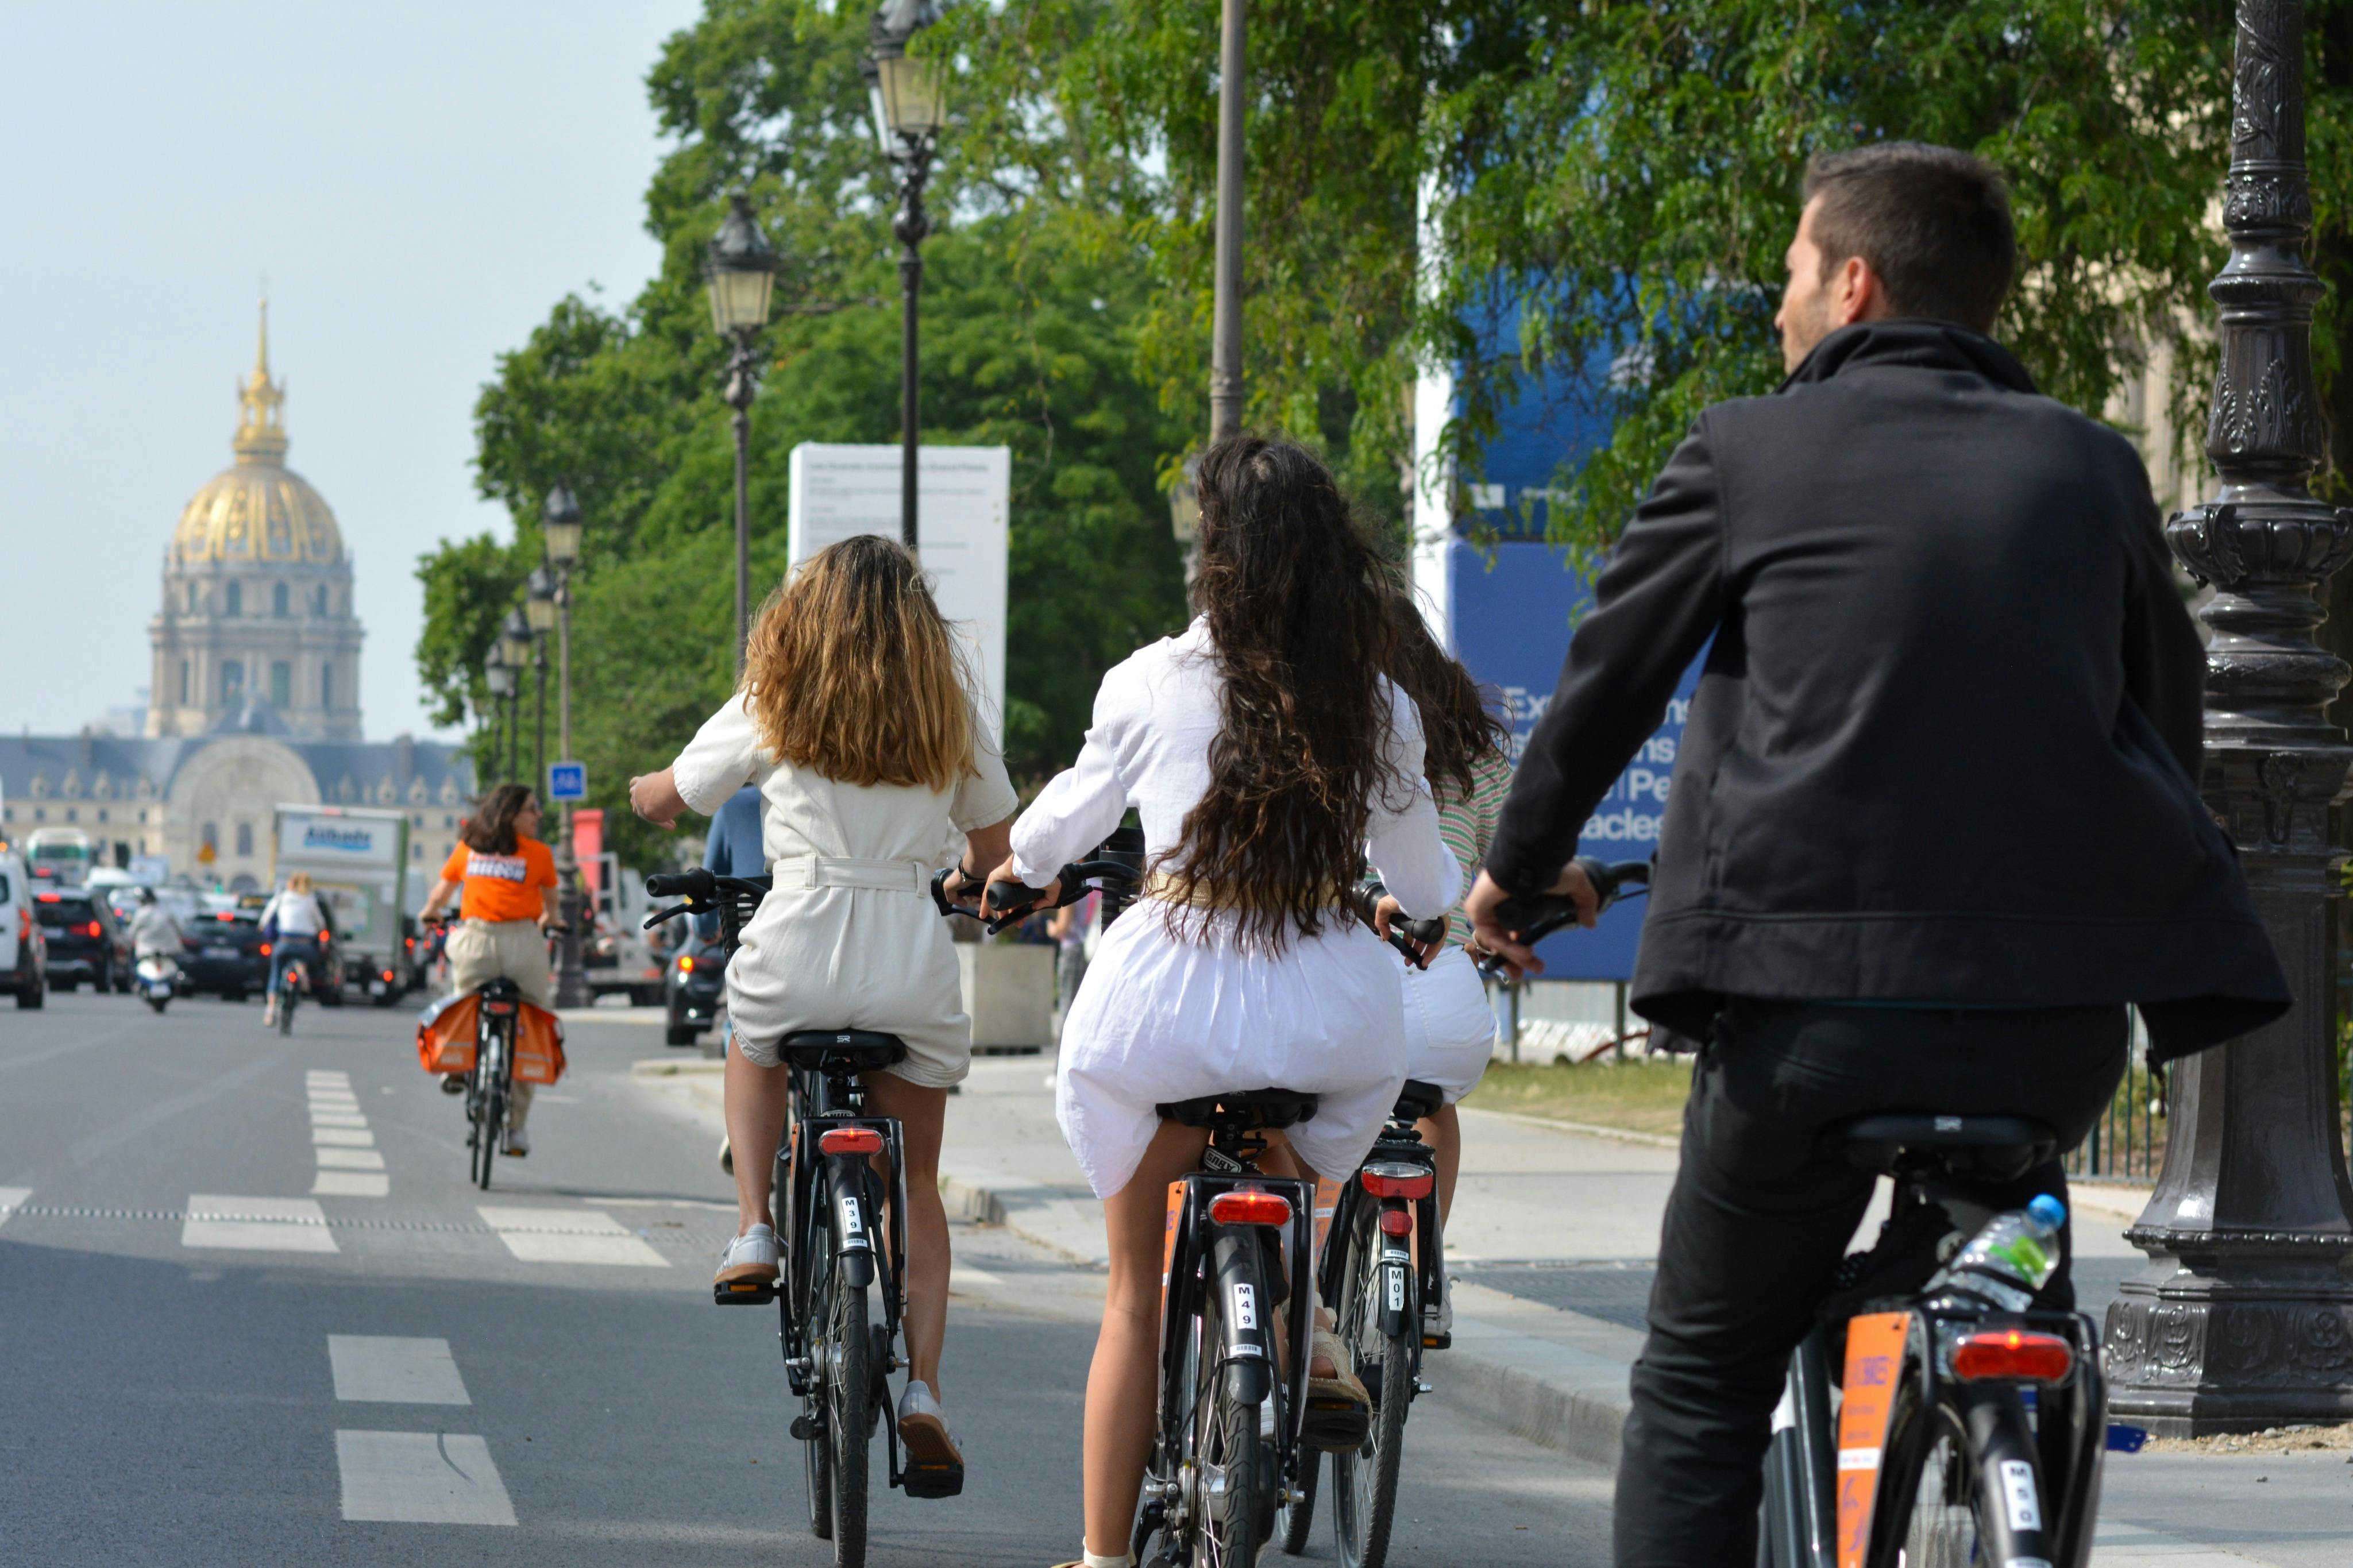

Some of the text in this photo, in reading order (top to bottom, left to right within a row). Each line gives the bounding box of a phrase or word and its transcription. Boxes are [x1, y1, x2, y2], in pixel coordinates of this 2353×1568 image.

[1207, 1152, 1236, 1172] ABUS
[845, 1199, 857, 1228] M39
[1391, 1270, 1402, 1307] M01
[1239, 1287, 1251, 1324] M49
